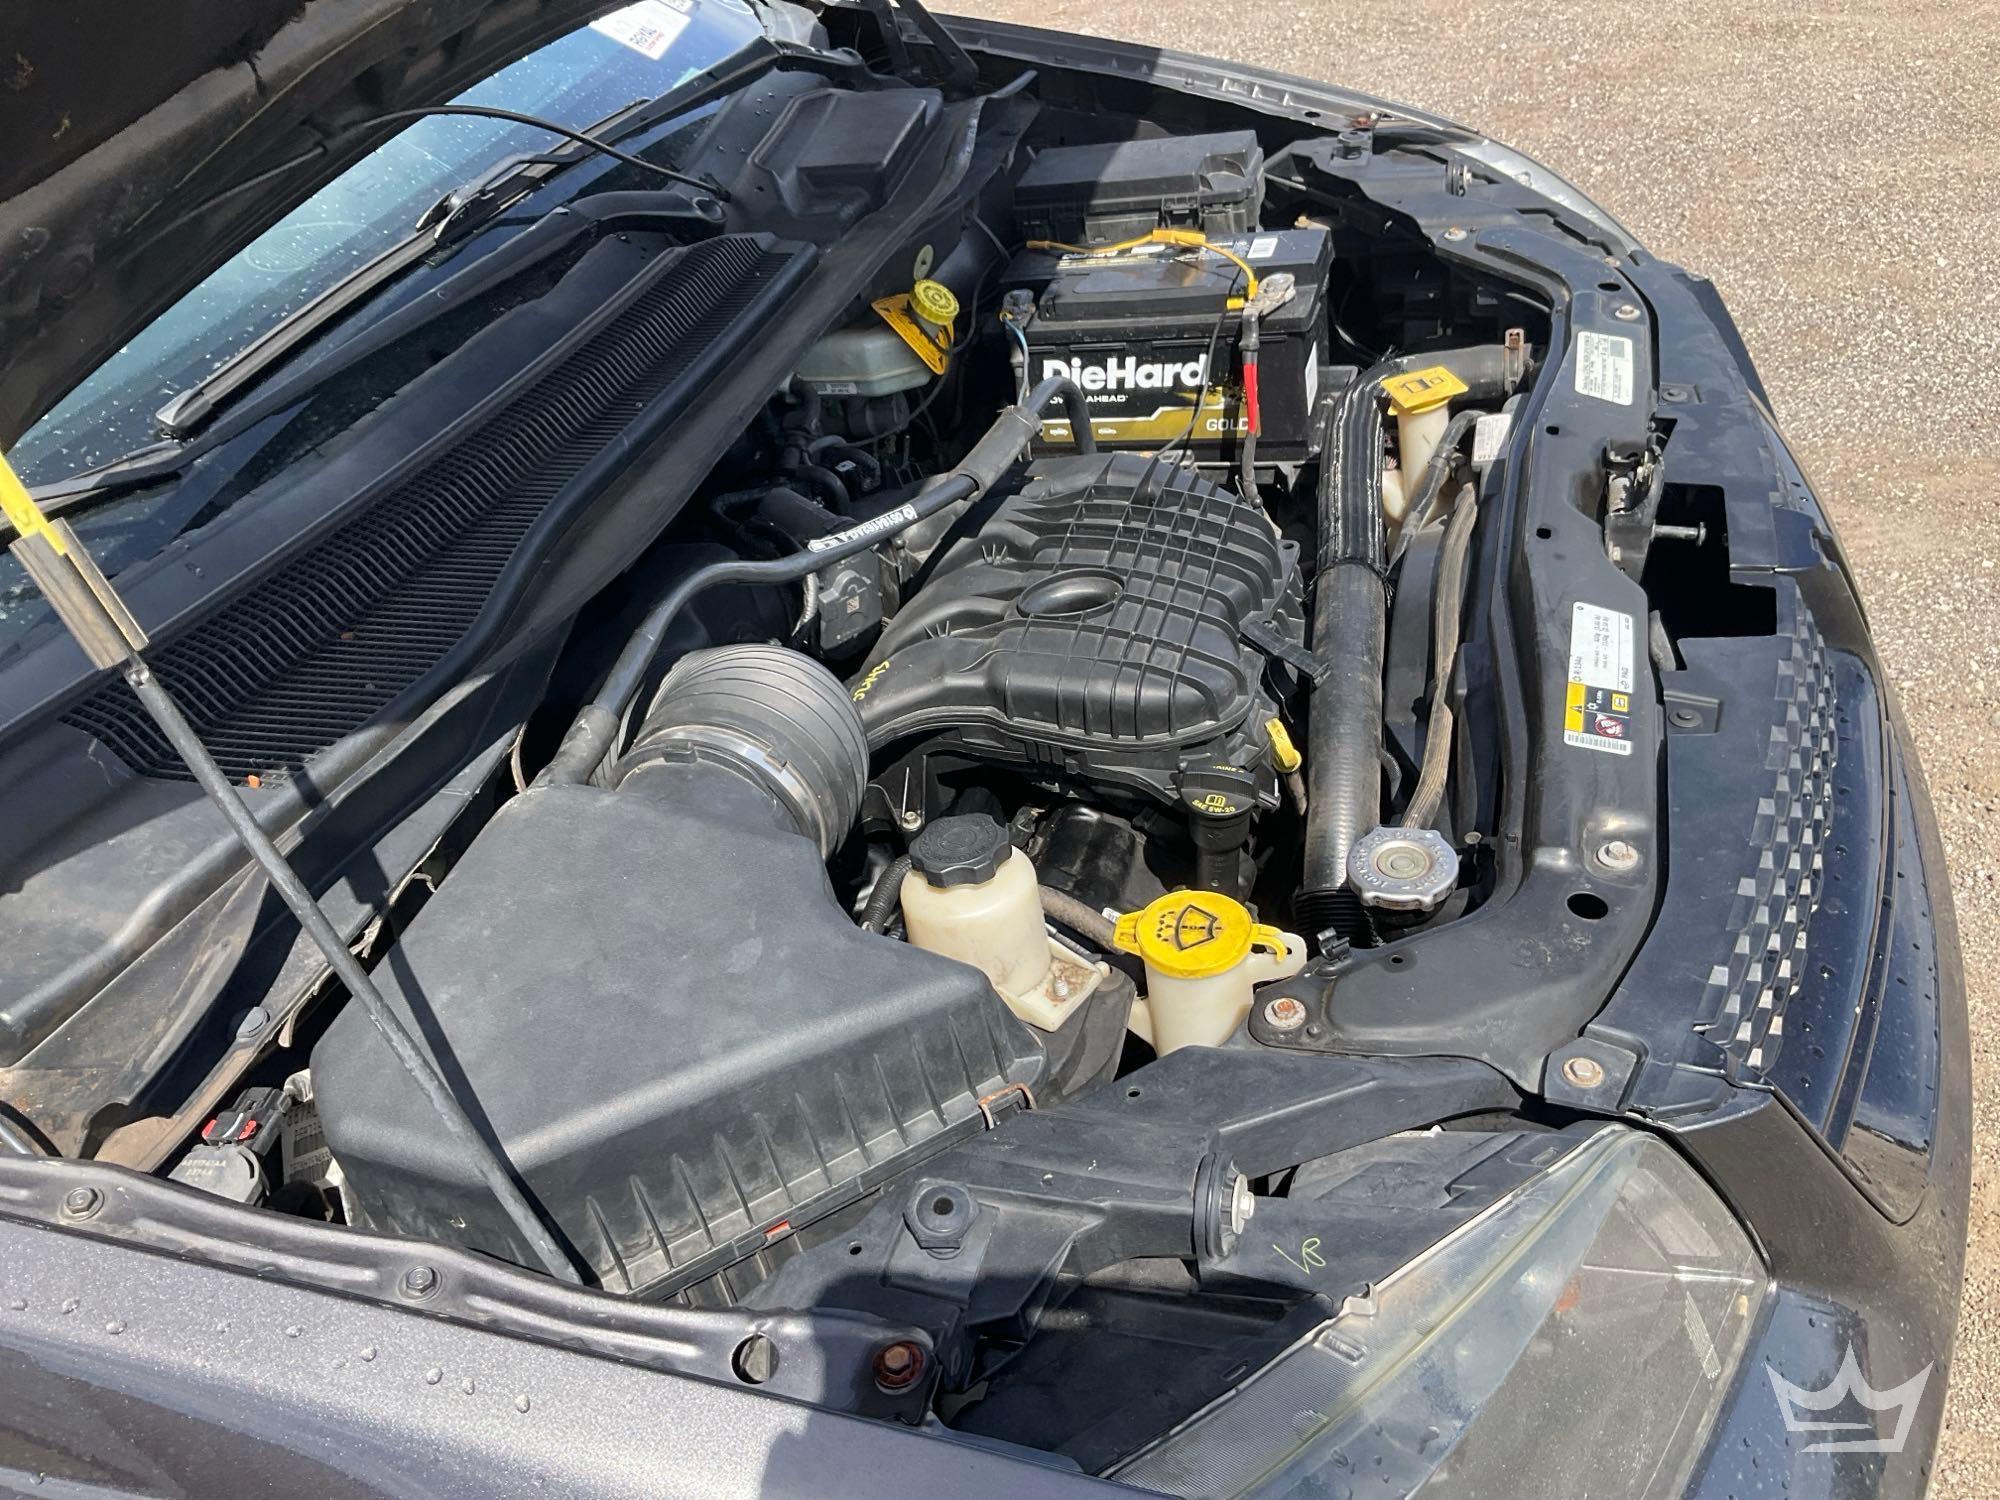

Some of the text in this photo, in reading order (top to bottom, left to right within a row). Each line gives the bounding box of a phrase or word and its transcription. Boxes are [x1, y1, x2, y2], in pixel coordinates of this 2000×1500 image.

[1043, 354, 1209, 390] DieHard
[1206, 417, 1248, 432] GOLD
[1191, 799, 1208, 810] SAE
